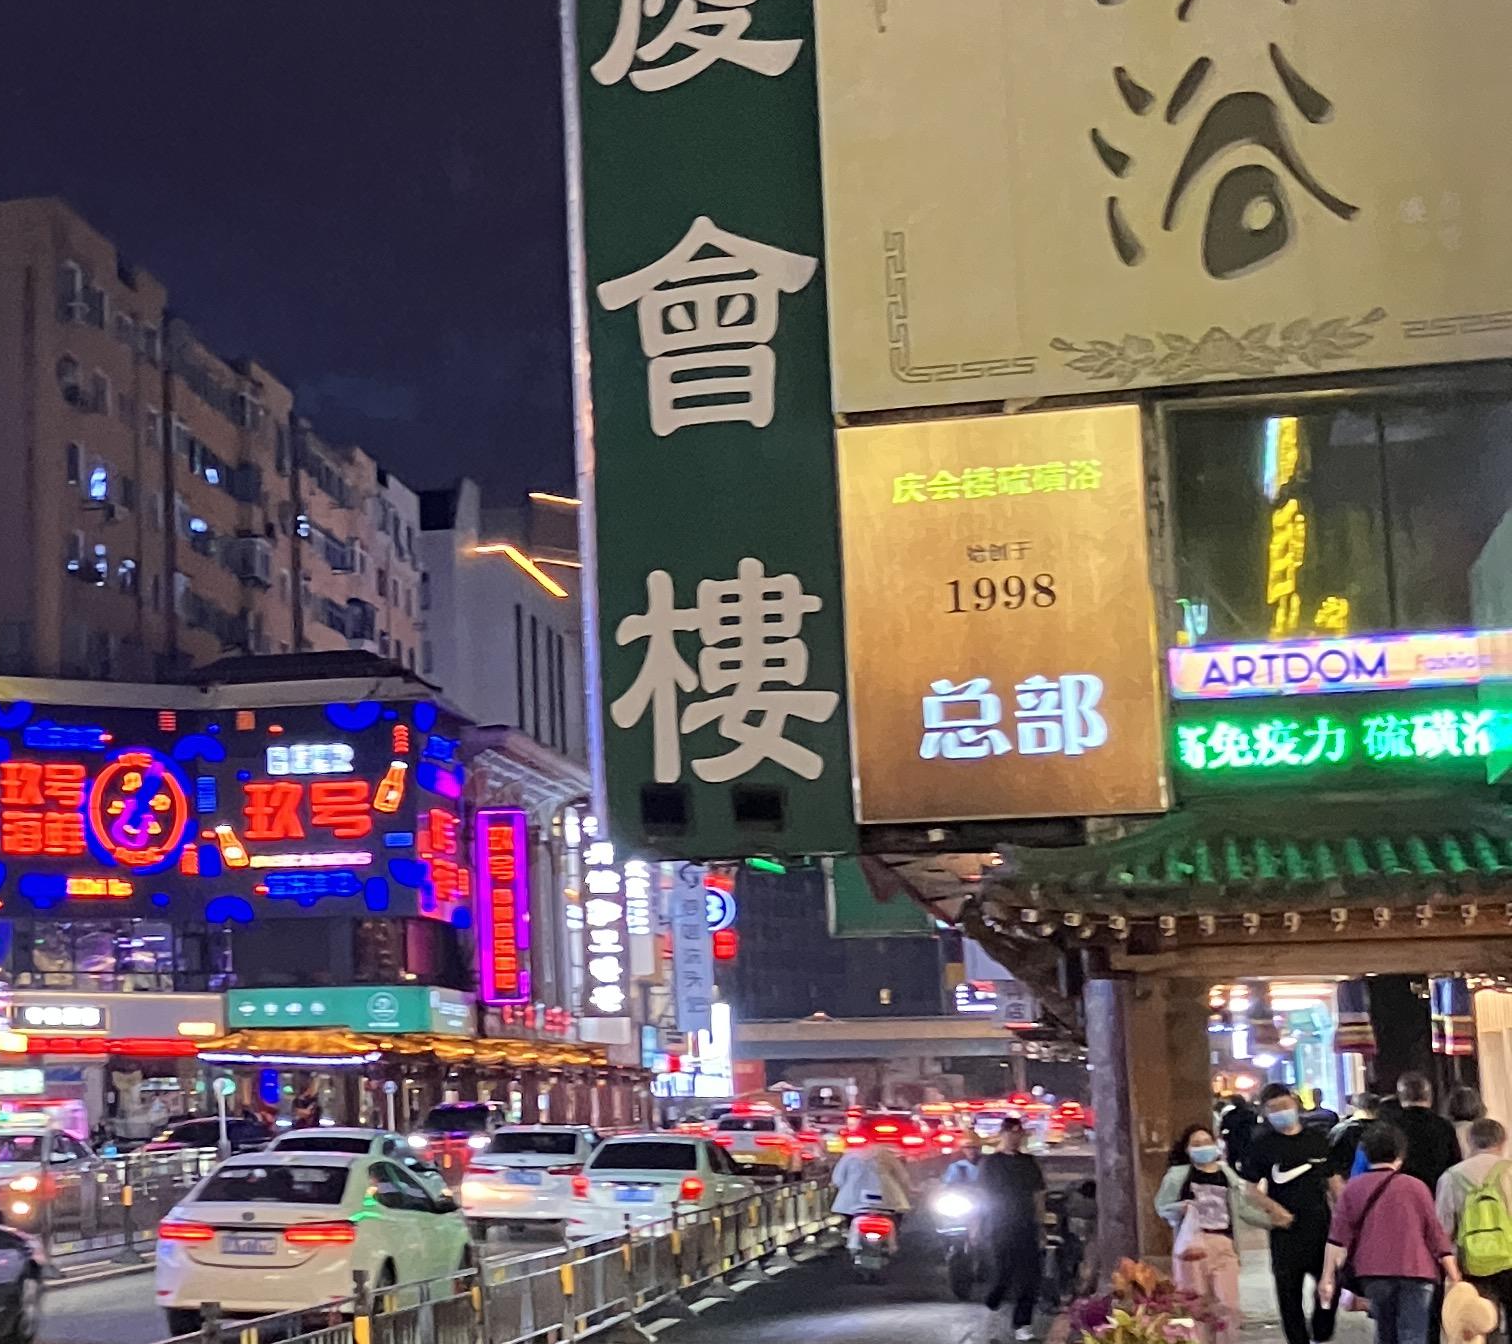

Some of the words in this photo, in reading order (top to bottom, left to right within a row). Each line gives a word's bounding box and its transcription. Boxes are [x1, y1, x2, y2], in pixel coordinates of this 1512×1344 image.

[892, 459, 1102, 504] 庆会楼硫磺浴
[966, 541, 1032, 563] 始创于
[944, 573, 1057, 613] 1998
[1202, 649, 1388, 689] ARTDOM
[919, 674, 1107, 760] 总部
[244, 780, 374, 840] 玖号
